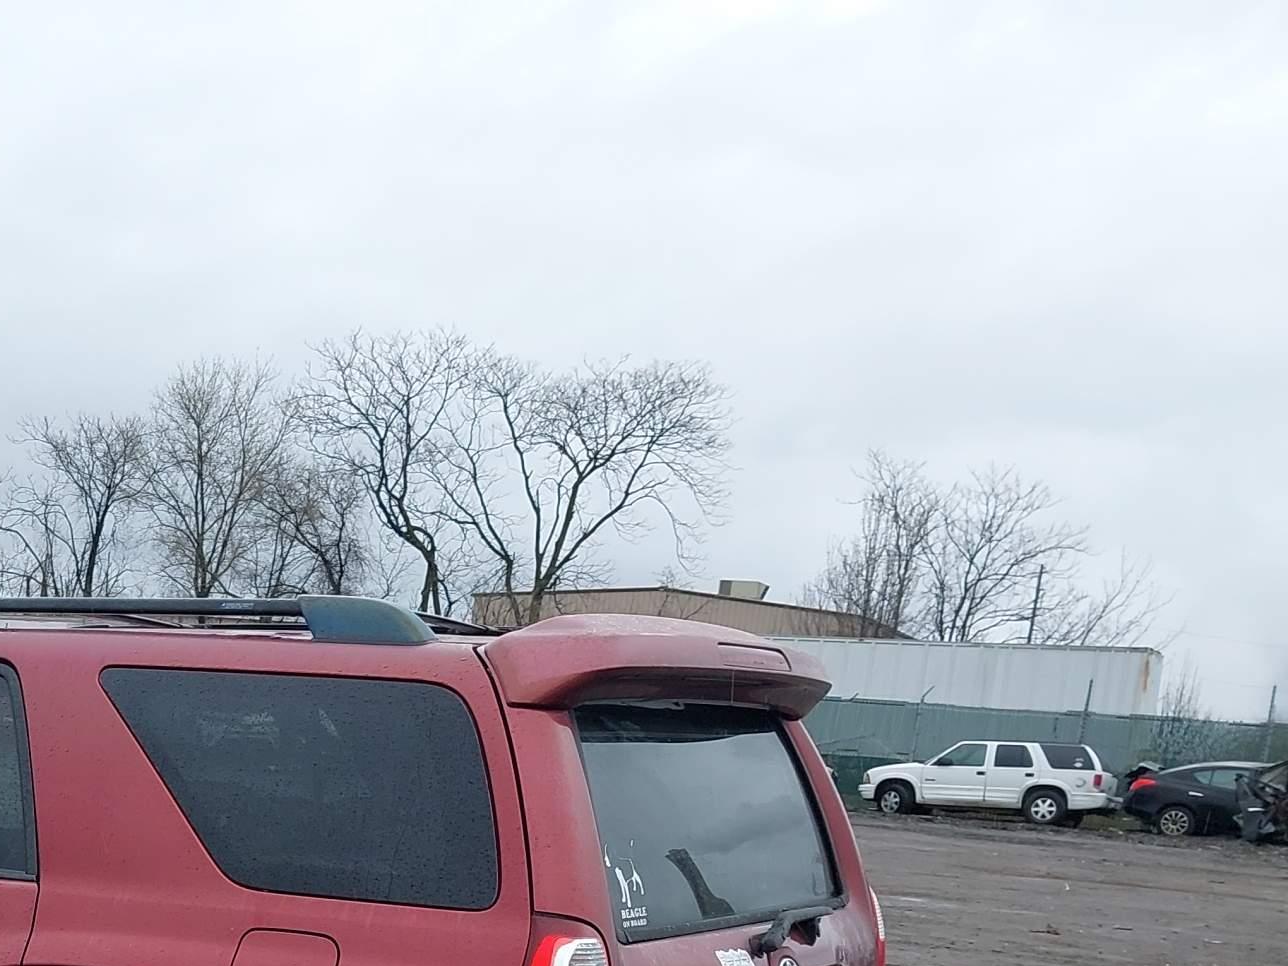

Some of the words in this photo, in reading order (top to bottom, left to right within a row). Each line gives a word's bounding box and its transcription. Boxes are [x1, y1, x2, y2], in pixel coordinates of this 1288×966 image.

[620, 906, 648, 919] BEAGLE
[622, 920, 630, 928] ON
[630, 918, 647, 927] BOARD
